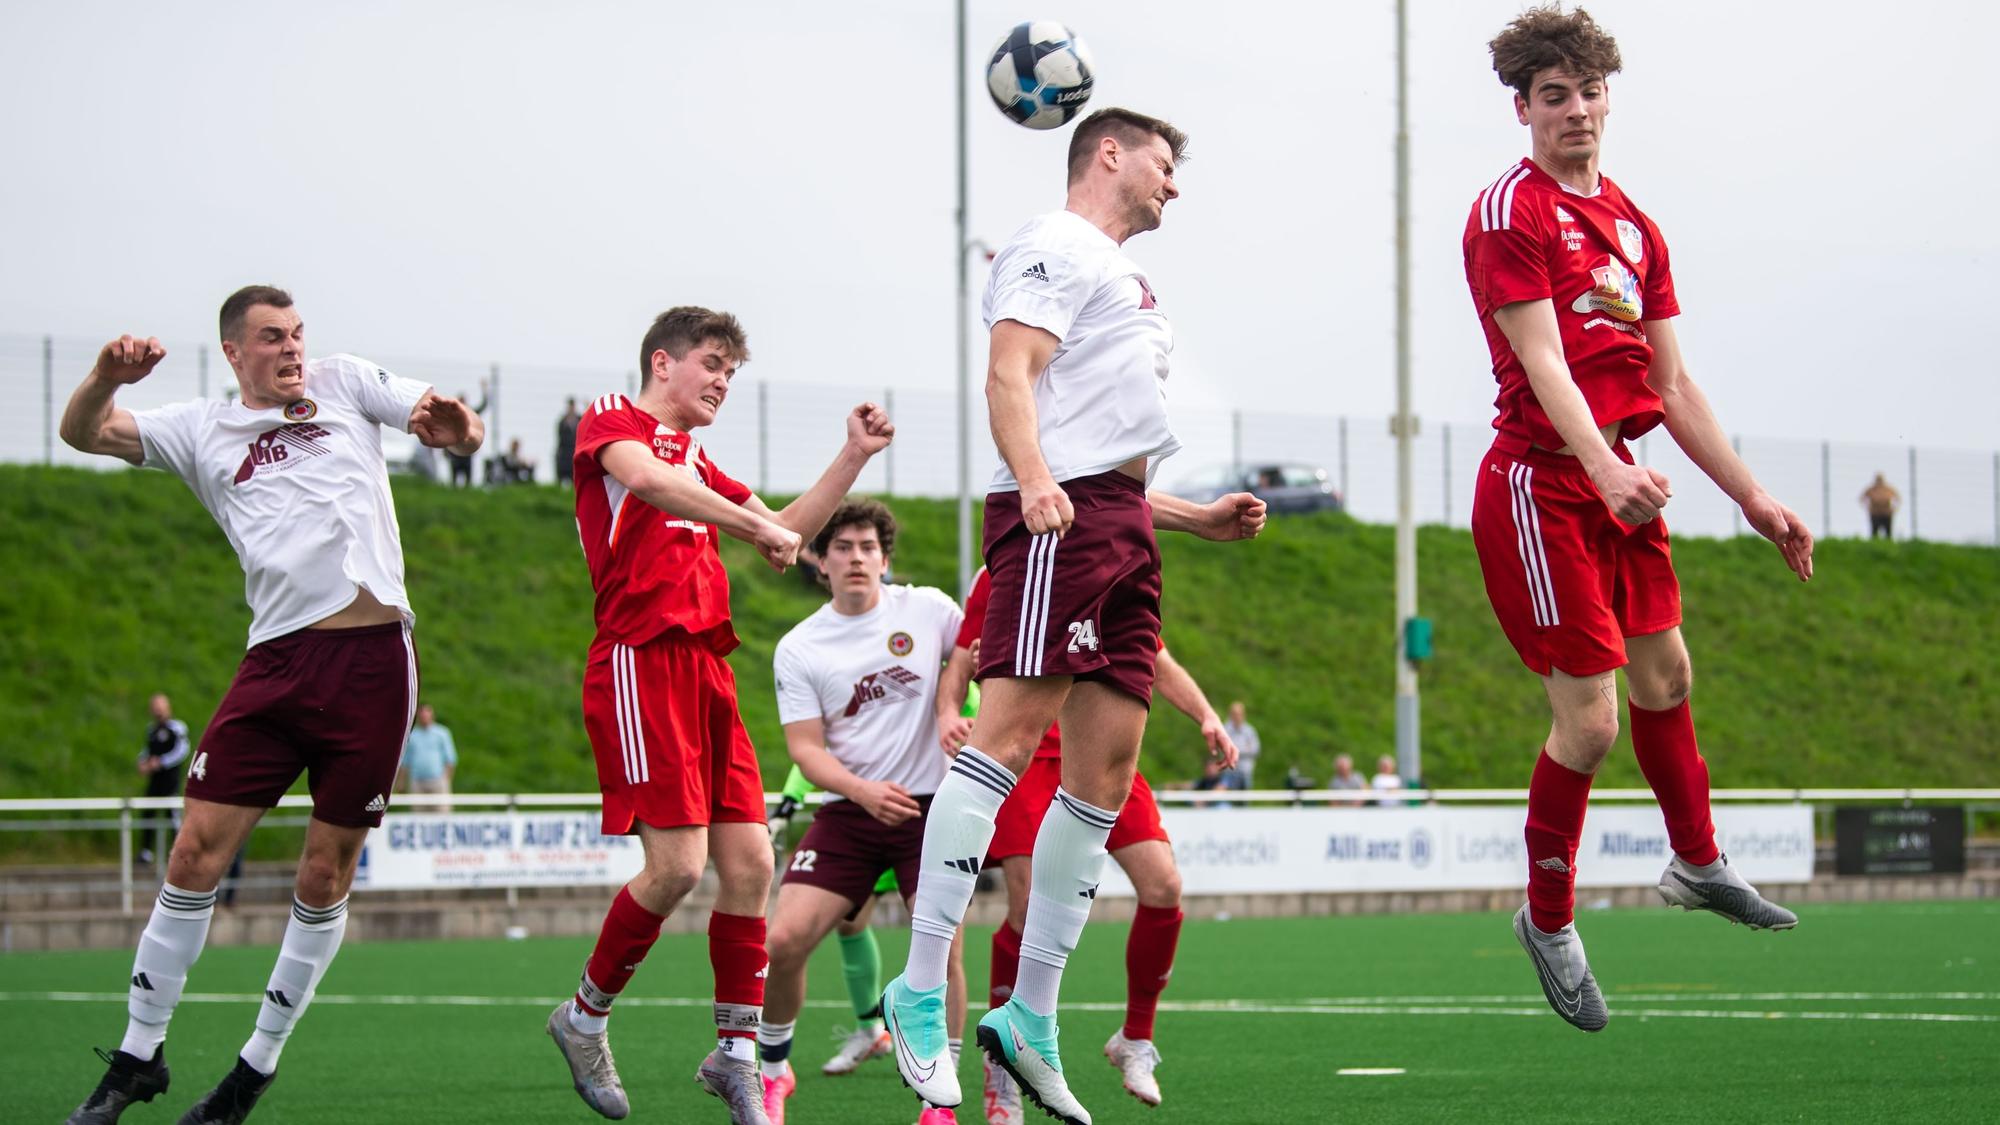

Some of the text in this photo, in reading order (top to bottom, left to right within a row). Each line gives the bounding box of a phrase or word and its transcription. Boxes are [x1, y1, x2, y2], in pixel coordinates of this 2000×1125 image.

[1022, 271, 1049, 282] adidas
[1067, 619, 1099, 653] 24
[388, 819, 511, 850] GEUENICH
[1326, 834, 1400, 862] Allianz
[1598, 830, 1664, 857] Allianz
[790, 849, 817, 872] 22
[1178, 832, 1279, 866] orbetzki
